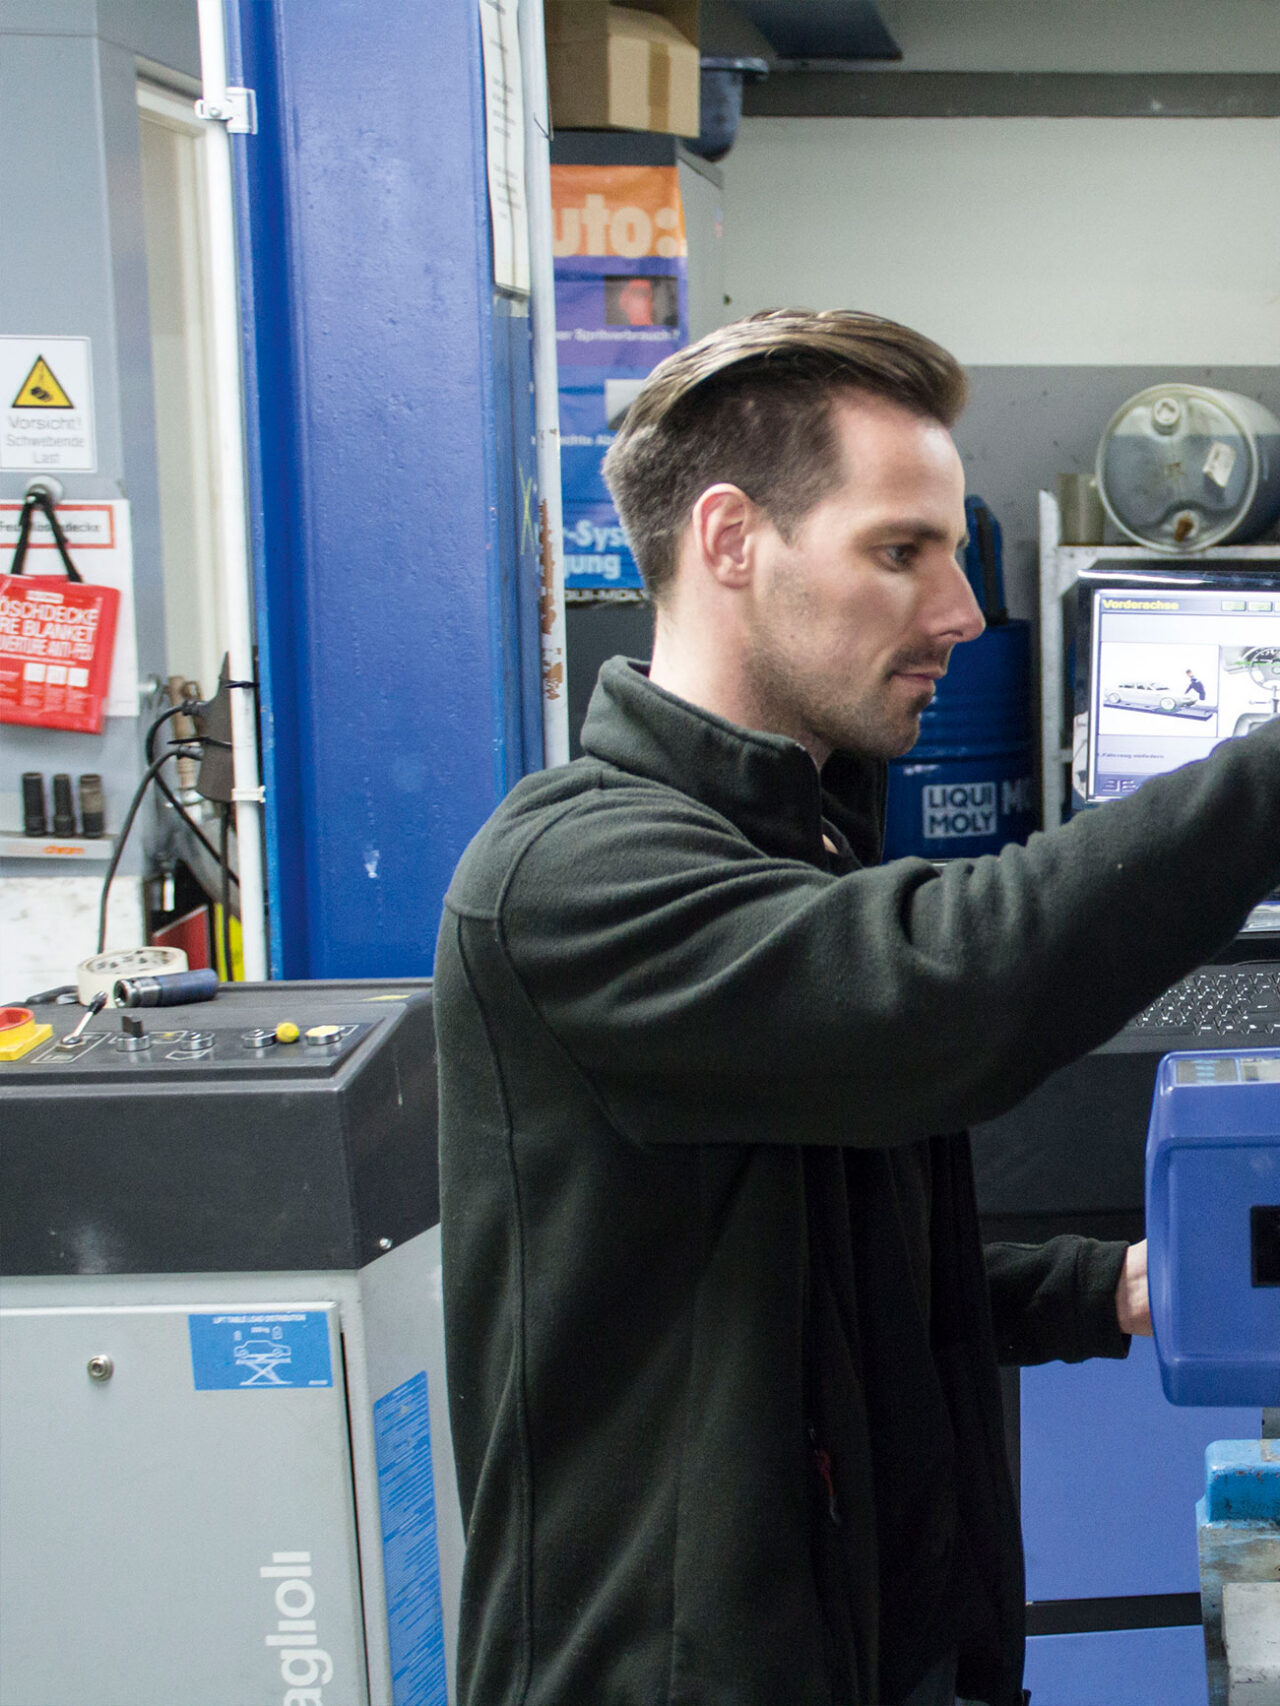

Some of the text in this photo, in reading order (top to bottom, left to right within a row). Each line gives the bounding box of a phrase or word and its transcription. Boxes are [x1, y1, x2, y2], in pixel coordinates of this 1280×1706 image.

[551, 194, 680, 258] uto:
[8, 415, 82, 430] Vorsicht!
[6, 433, 85, 448] Schwebende
[33, 451, 60, 464] Last
[0, 596, 98, 626] ÖSCHDECKE
[1101, 598, 1180, 611] Vorderachse
[22, 619, 97, 643] BLANKET
[928, 785, 992, 809] LIQUI
[929, 810, 993, 834] MOLY
